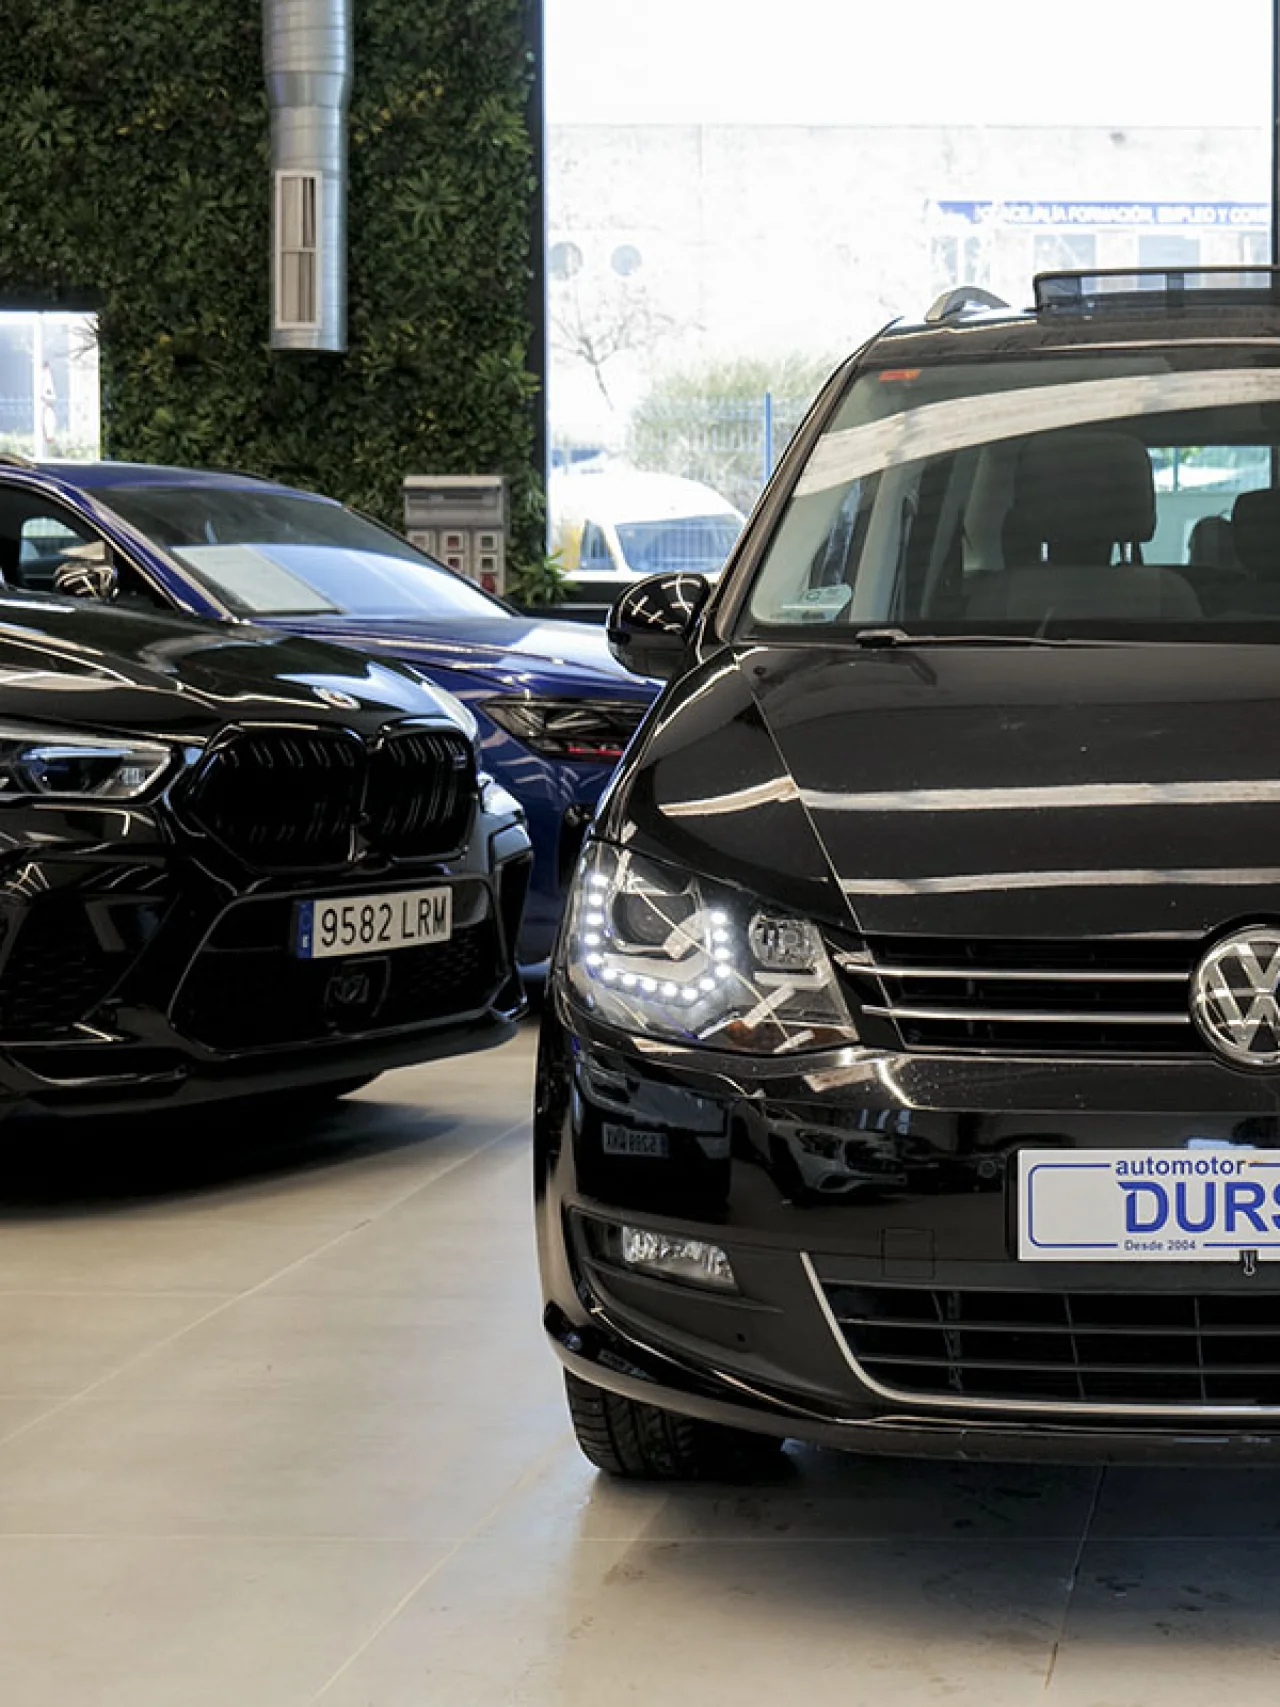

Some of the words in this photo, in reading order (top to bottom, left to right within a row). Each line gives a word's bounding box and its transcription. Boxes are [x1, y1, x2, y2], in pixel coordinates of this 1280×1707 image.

[321, 902, 393, 947] 9582
[401, 895, 446, 940] LRM
[1115, 1156, 1246, 1175] automotor
[1124, 1239, 1163, 1250] Desde
[1167, 1239, 1196, 1250] 2004
